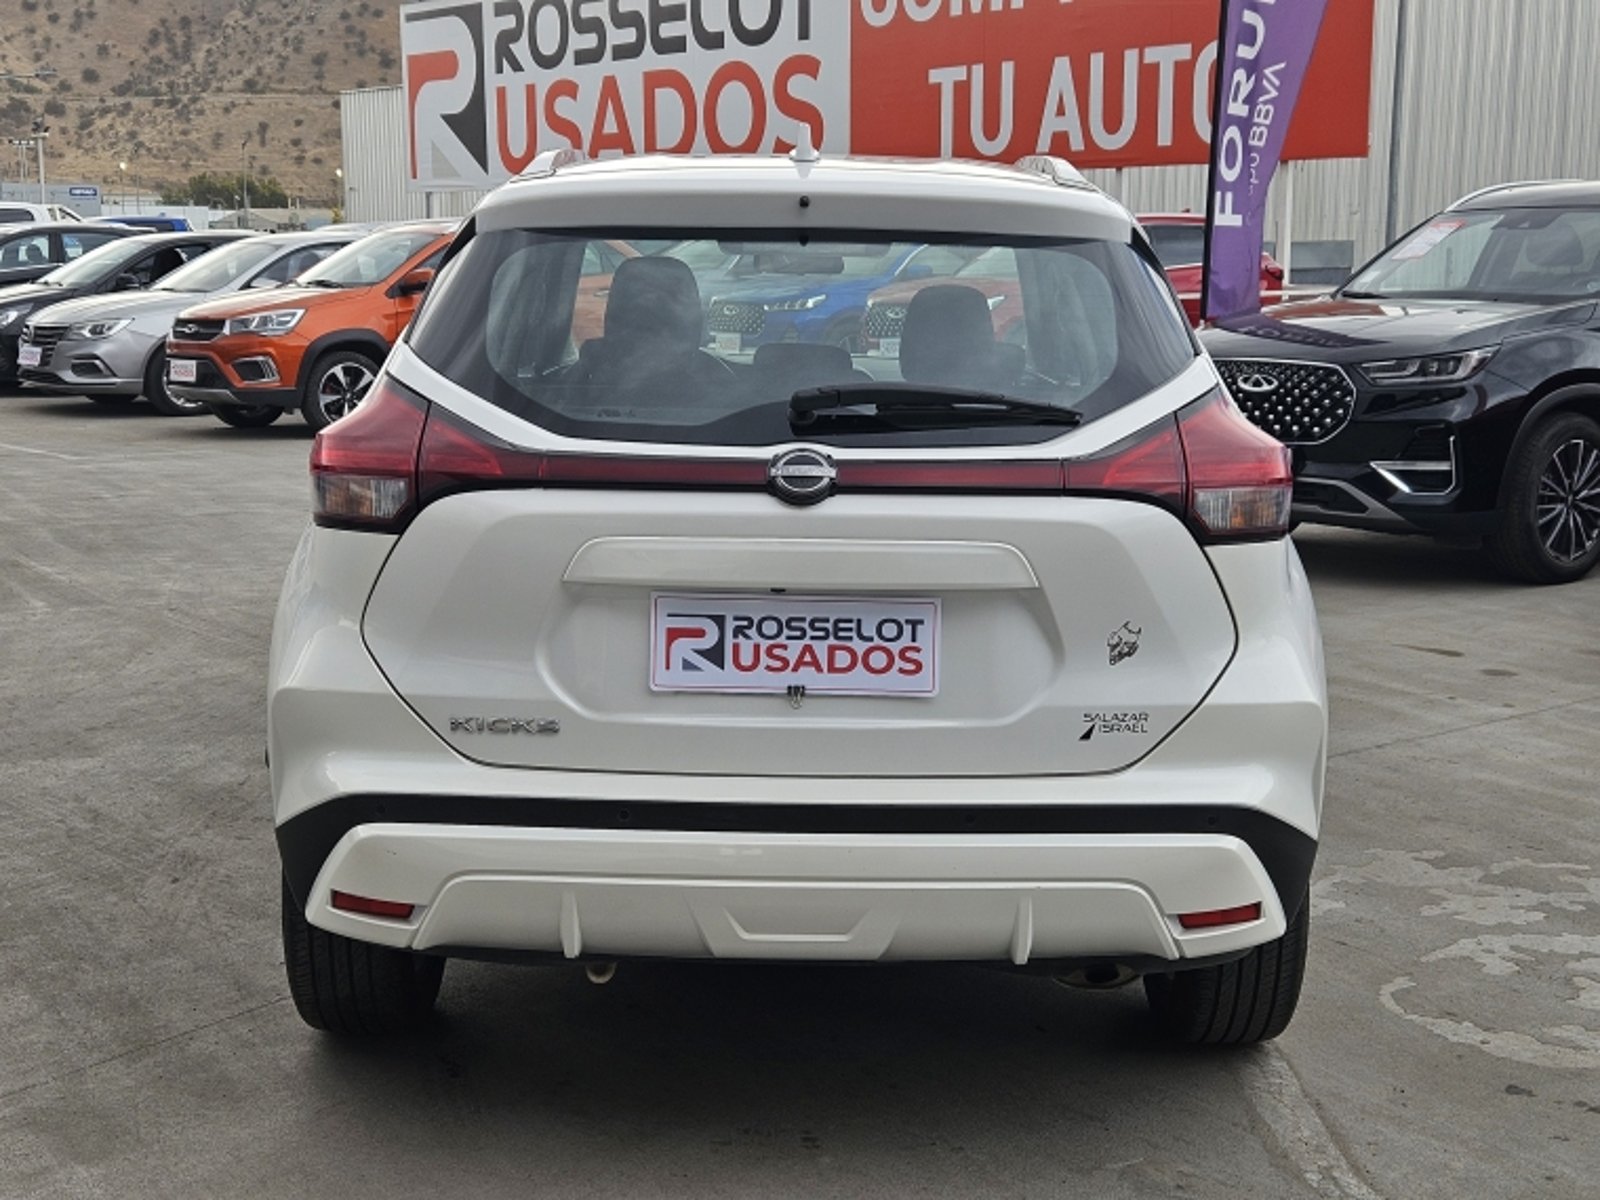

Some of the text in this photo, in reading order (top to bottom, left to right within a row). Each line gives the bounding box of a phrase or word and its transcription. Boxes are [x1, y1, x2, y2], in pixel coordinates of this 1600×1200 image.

[496, 54, 825, 176] USADOS
[928, 60, 1015, 160] TU
[1214, 0, 1276, 226] FORU
[1248, 61, 1287, 147] BBVA
[732, 615, 925, 643] ROSSELOT
[732, 643, 924, 676] USADOS
[449, 717, 560, 735] KICKS
[1083, 711, 1149, 722] SALAZAR
[1099, 723, 1148, 733] ISRAEL
